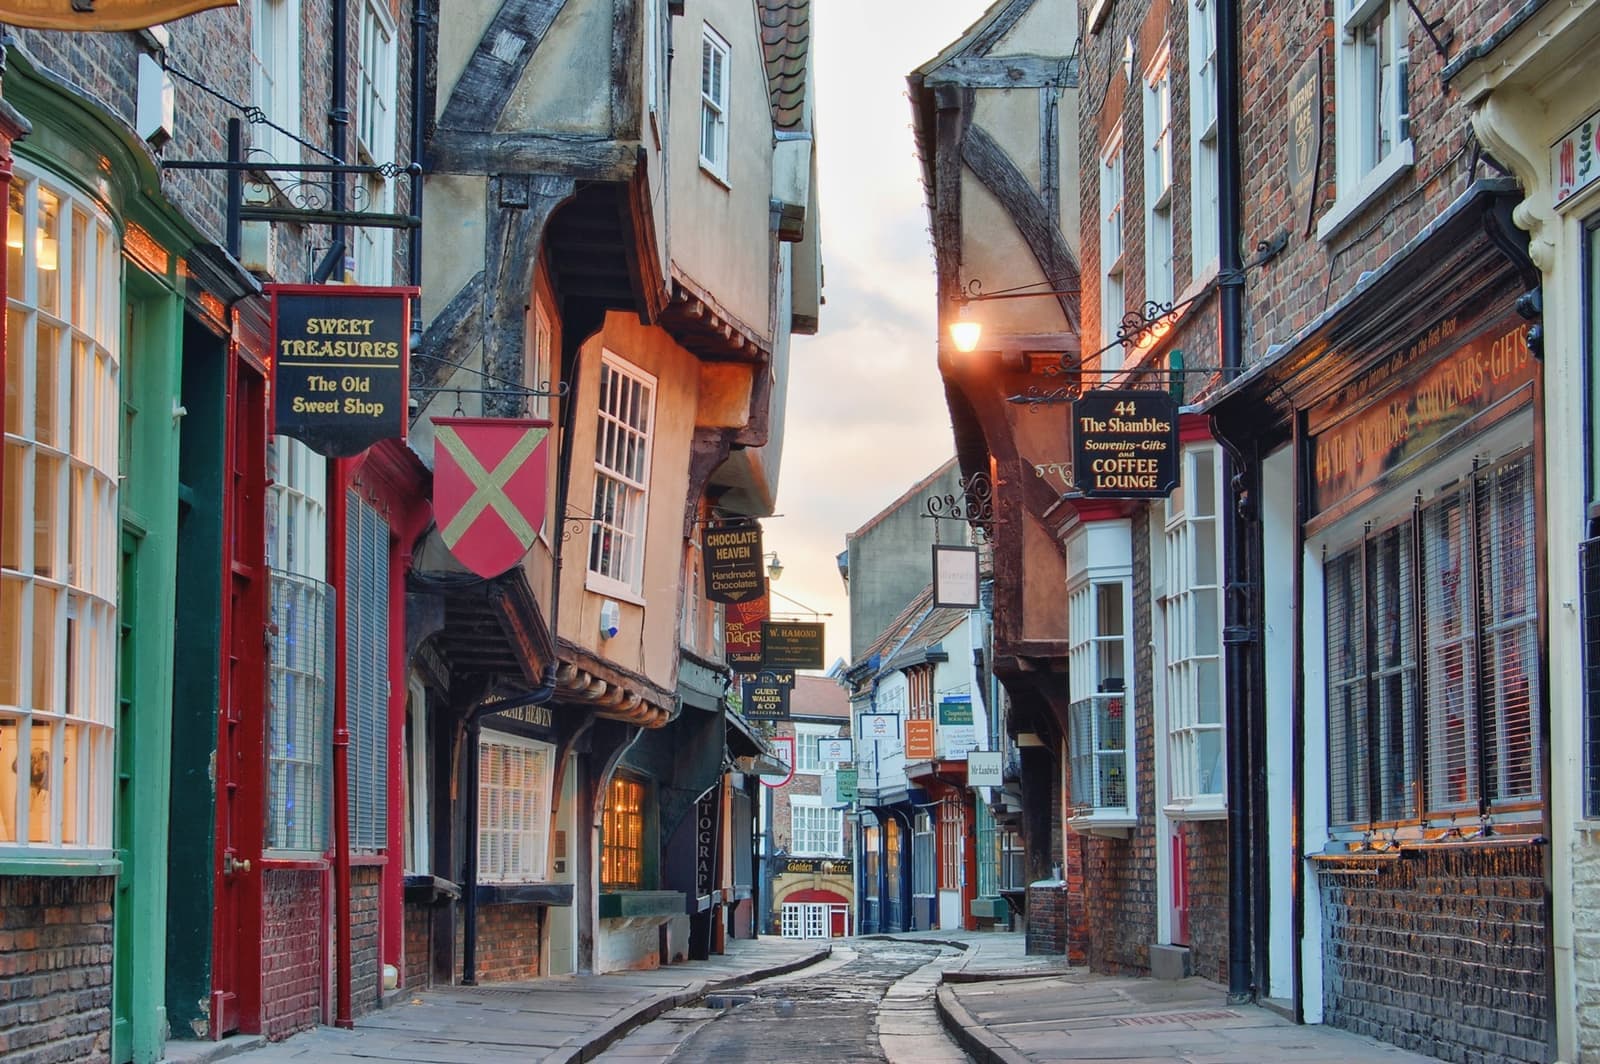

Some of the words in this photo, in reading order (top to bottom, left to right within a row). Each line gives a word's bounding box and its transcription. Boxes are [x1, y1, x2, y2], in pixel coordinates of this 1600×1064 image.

[306, 318, 374, 335] SWEET
[281, 340, 398, 358] TREASURES
[307, 376, 336, 392] The
[342, 376, 370, 392] Old
[292, 396, 340, 412] Sweet
[344, 398, 384, 417] Shop
[1114, 401, 1136, 416] 44
[1080, 418, 1106, 432] The
[1108, 418, 1170, 432] Shambles
[1092, 459, 1158, 472] COFFEE
[1096, 475, 1158, 488] LOUNGE
[708, 532, 758, 546] CHOCOLATE
[716, 546, 750, 560] HEAVEN
[712, 570, 756, 580] Handmade
[712, 580, 758, 590] Chocolates
[524, 704, 552, 728] HEAVEN
[788, 862, 812, 872] Golden
